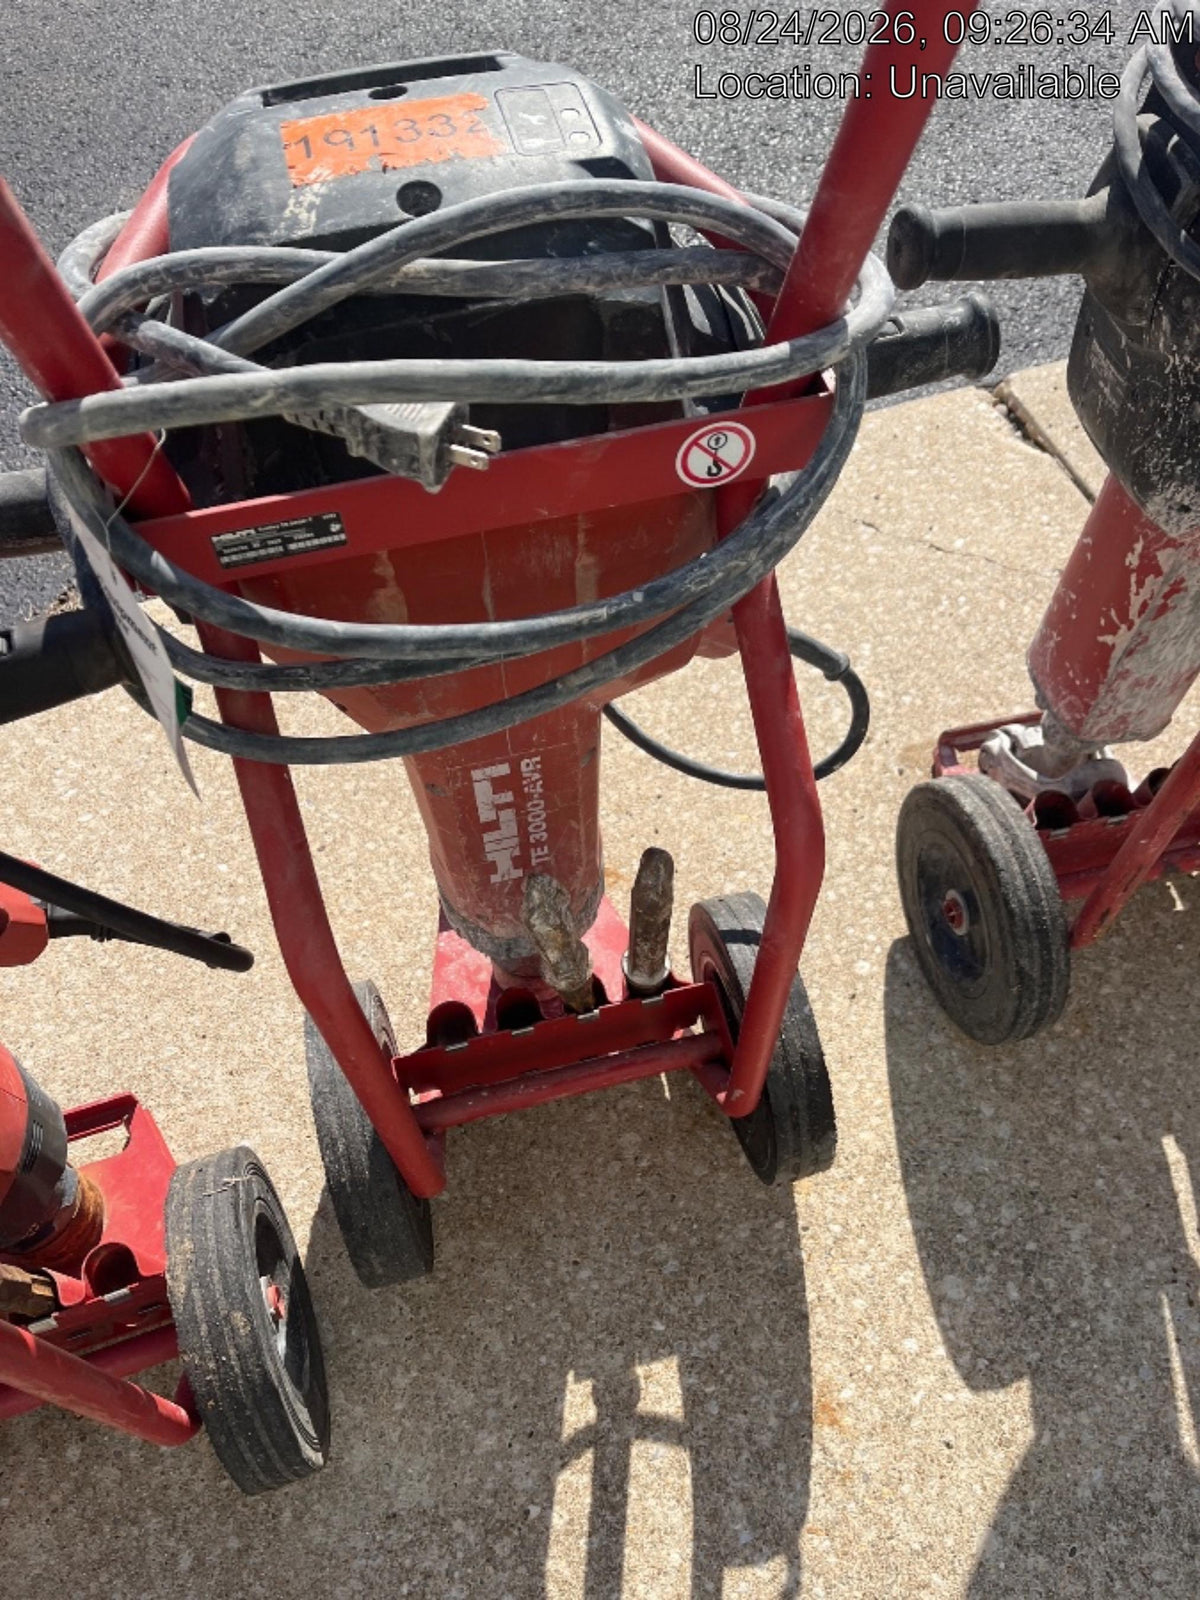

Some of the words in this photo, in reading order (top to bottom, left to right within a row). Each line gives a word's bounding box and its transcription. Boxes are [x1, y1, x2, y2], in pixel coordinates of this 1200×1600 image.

[470, 762, 523, 884] HILTI
[520, 756, 549, 844] 3000-AVR
[531, 845, 552, 867] TE
